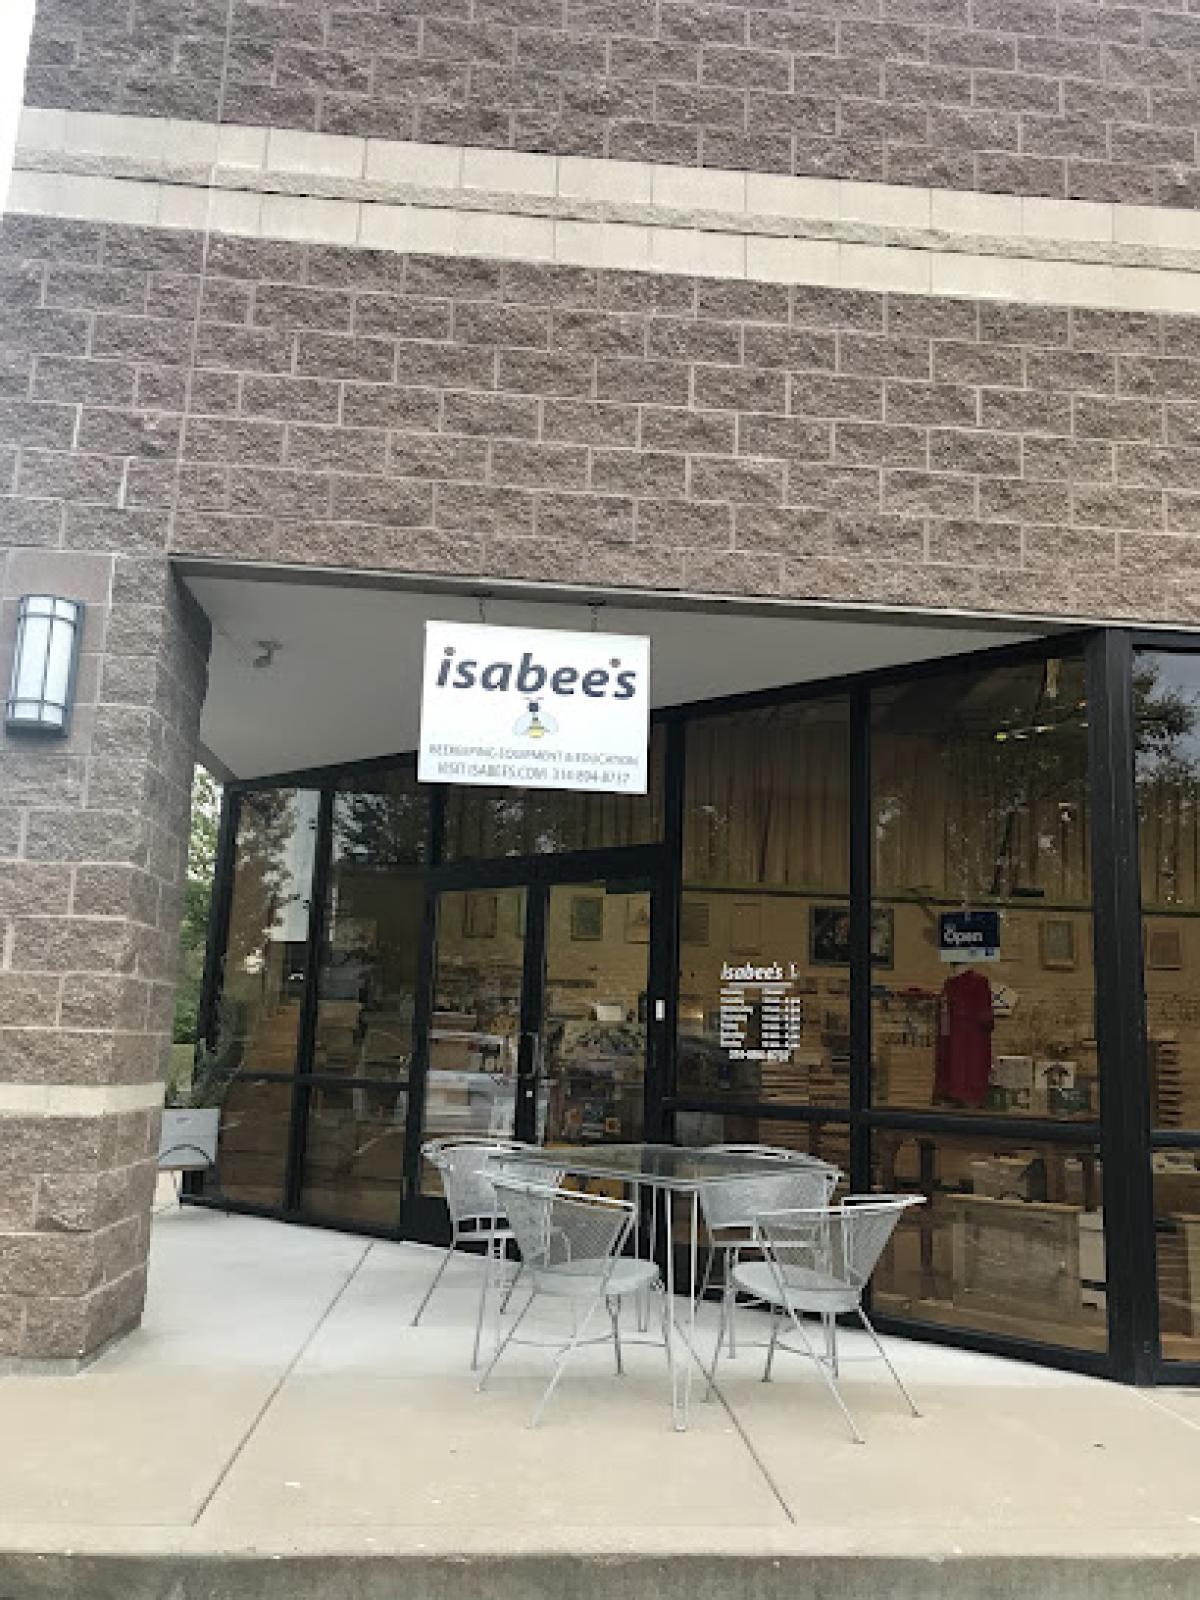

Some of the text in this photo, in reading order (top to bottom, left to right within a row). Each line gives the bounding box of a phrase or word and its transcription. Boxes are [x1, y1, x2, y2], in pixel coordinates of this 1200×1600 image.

[436, 646, 637, 699] isabee's
[500, 747, 563, 762] EQUIPMENT
[576, 752, 639, 767] EDUCATION
